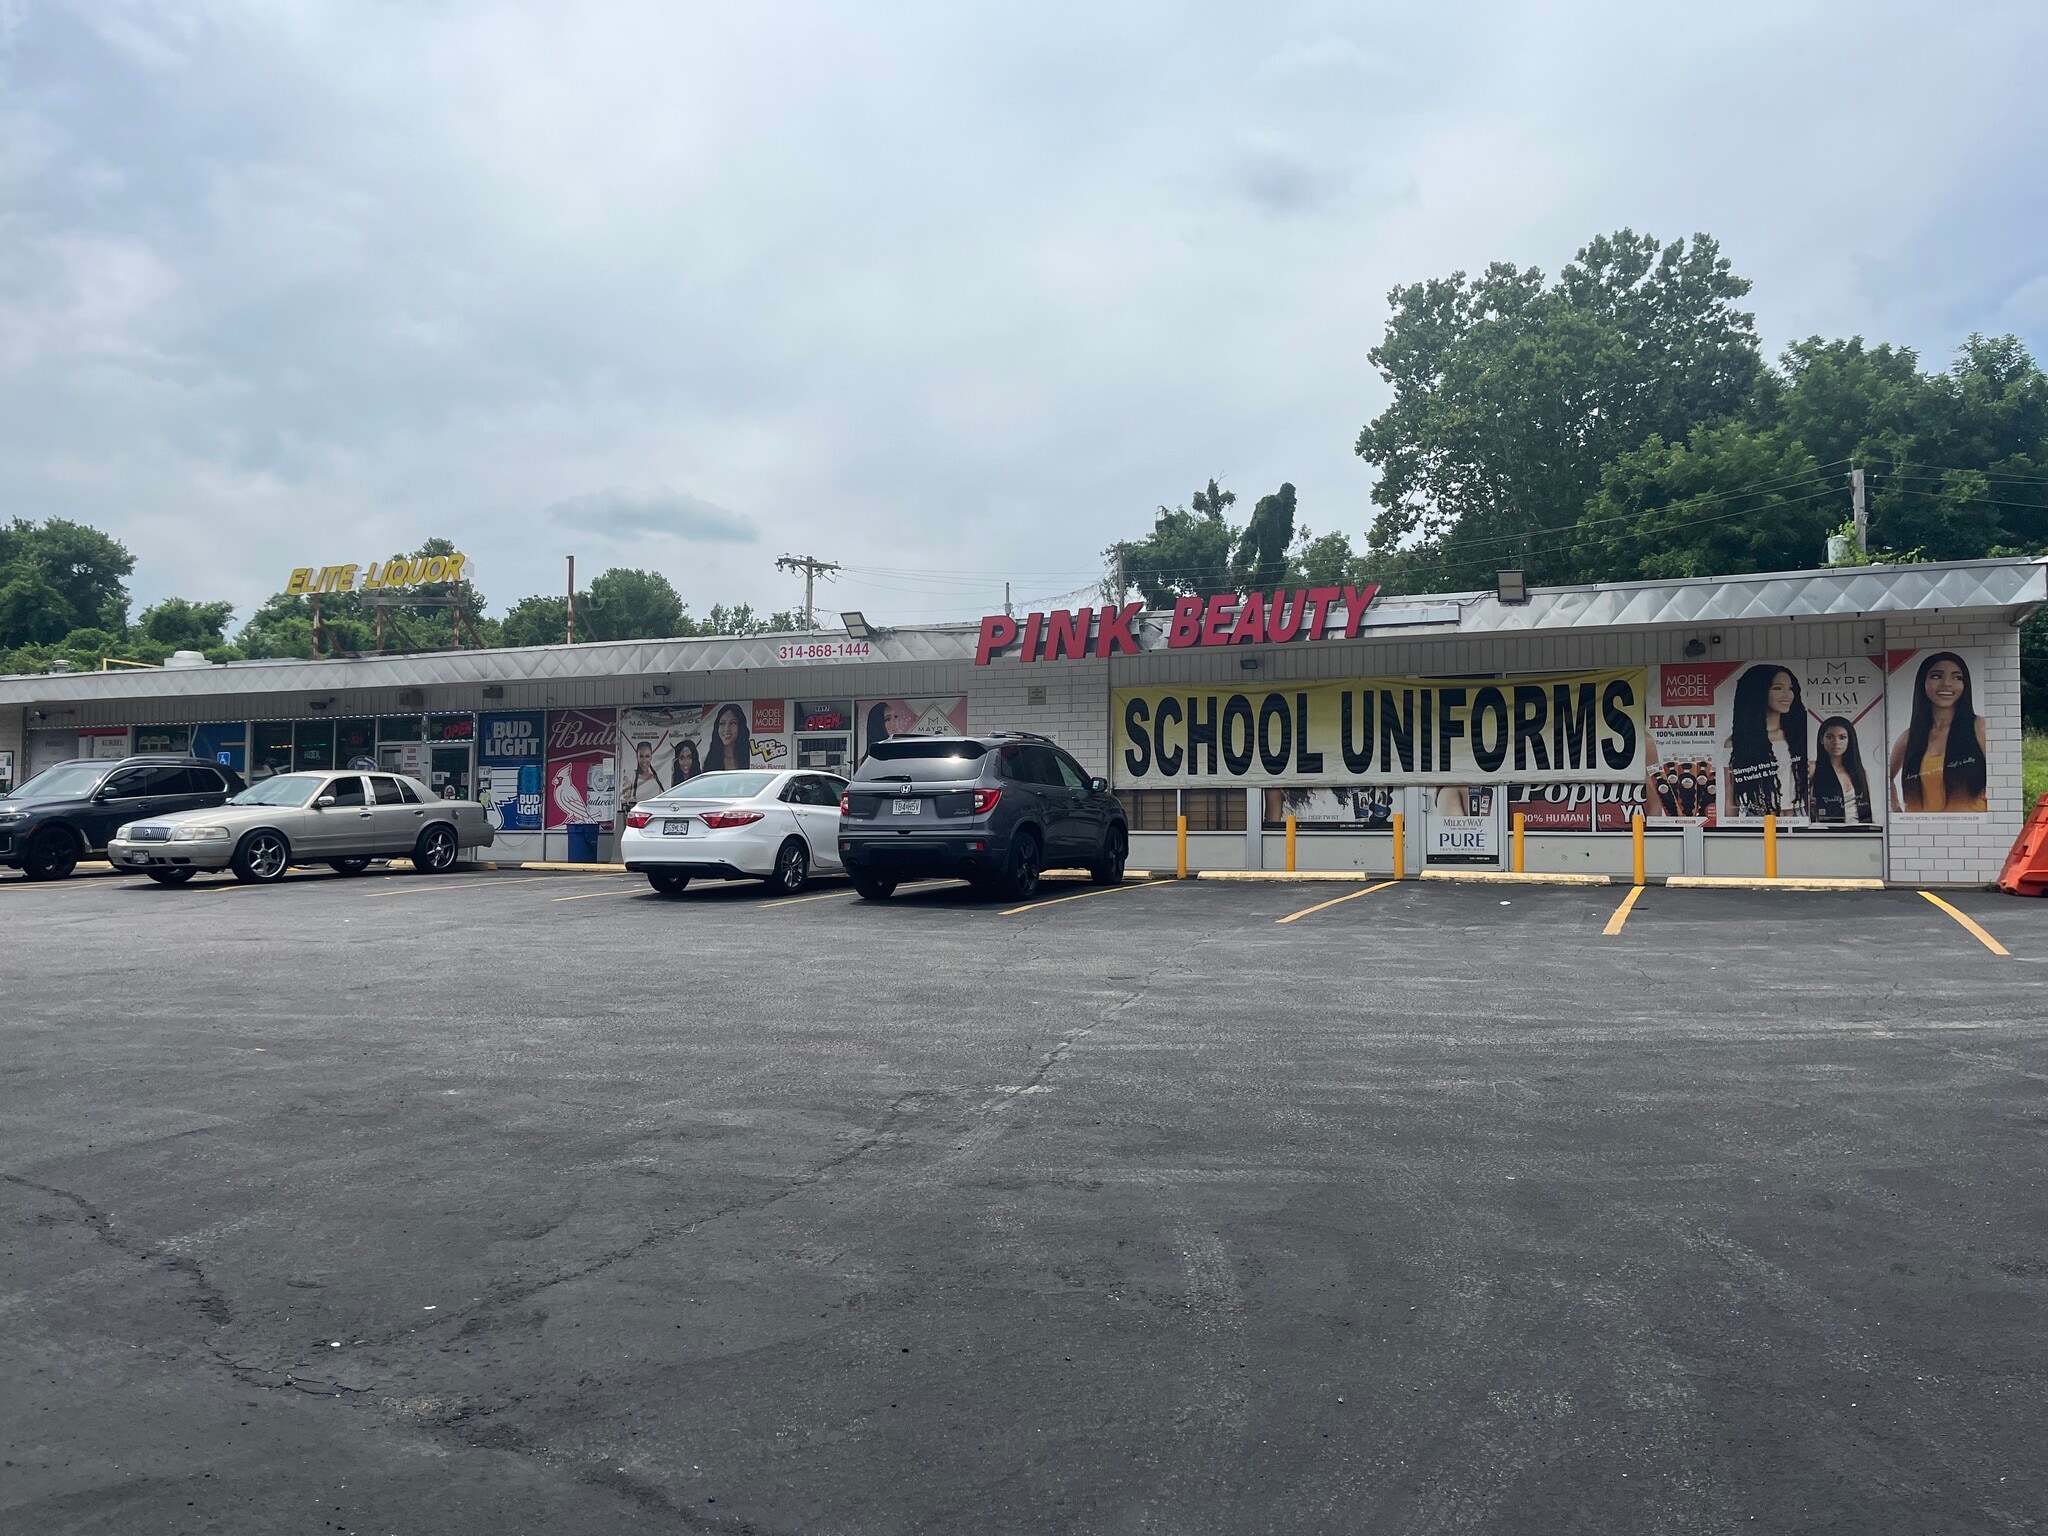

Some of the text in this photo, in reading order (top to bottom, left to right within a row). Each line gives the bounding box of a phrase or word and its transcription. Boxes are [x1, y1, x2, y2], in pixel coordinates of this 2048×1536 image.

[287, 553, 466, 595] ELITE LIQUOR
[975, 583, 1381, 666] PINK BEAUTY
[779, 642, 870, 659] 314-868-1444
[1666, 674, 1709, 686] MODEL
[1807, 675, 1867, 685] MAYDE
[1666, 686, 1709, 697] MODEL
[1820, 691, 1858, 706] TESSA
[755, 708, 782, 718] MODEL
[443, 720, 473, 739] OPEN
[493, 720, 533, 739] BUD
[755, 718, 782, 727] MODEL
[804, 712, 842, 731] OPEN
[1124, 679, 1636, 778] SCHOOL UNIFORMS
[485, 738, 540, 757] LIGHT
[749, 739, 777, 756] Lace
[762, 744, 788, 762] Lace
[1732, 764, 1758, 776] Simply
[1758, 761, 1771, 770] the
[1734, 776, 1744, 784] to
[1743, 772, 1762, 781] twist
[1762, 770, 1769, 778] &
[519, 794, 540, 805] BUD
[517, 803, 543, 815] LIGHT
[1546, 813, 1584, 822] HUMAN
[1439, 829, 1486, 848] PURÉ
